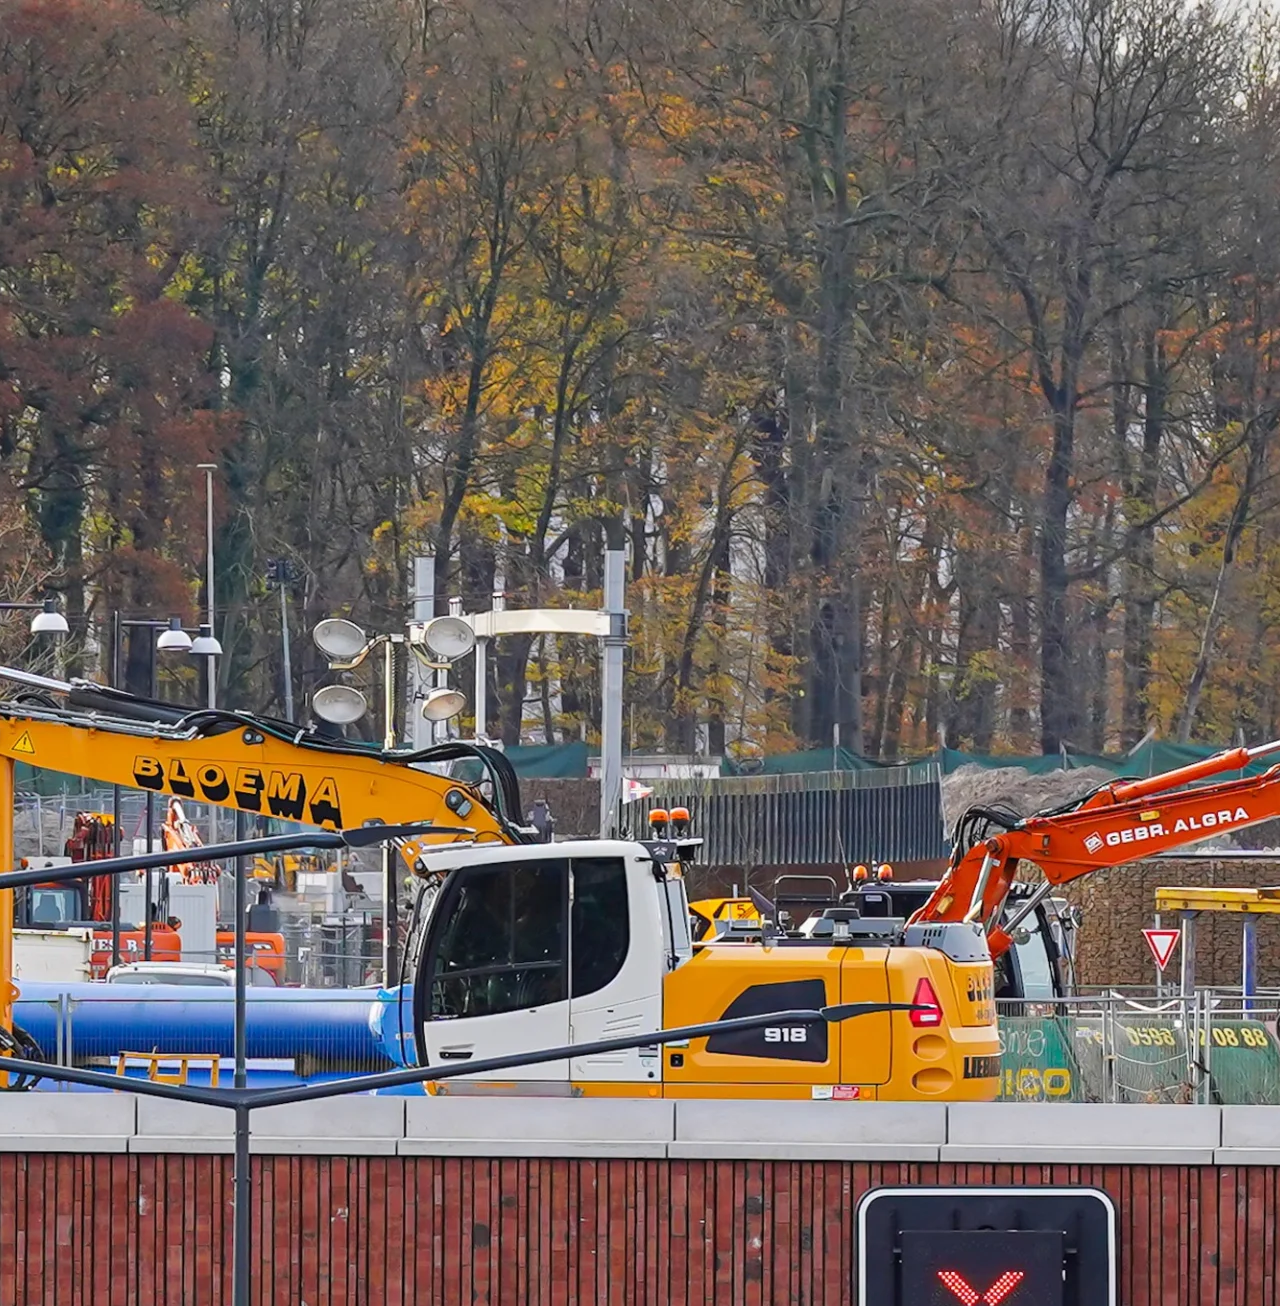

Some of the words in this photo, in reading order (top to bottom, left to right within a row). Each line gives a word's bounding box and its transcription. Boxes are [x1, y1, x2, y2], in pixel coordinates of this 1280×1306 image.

[133, 755, 343, 829] BLOEMA
[1106, 824, 1170, 847] GEBR.
[1174, 807, 1249, 833] ALGRA
[764, 1028, 806, 1042] 918
[1212, 1027, 1239, 1046] 08
[1243, 1027, 1269, 1046] 88
